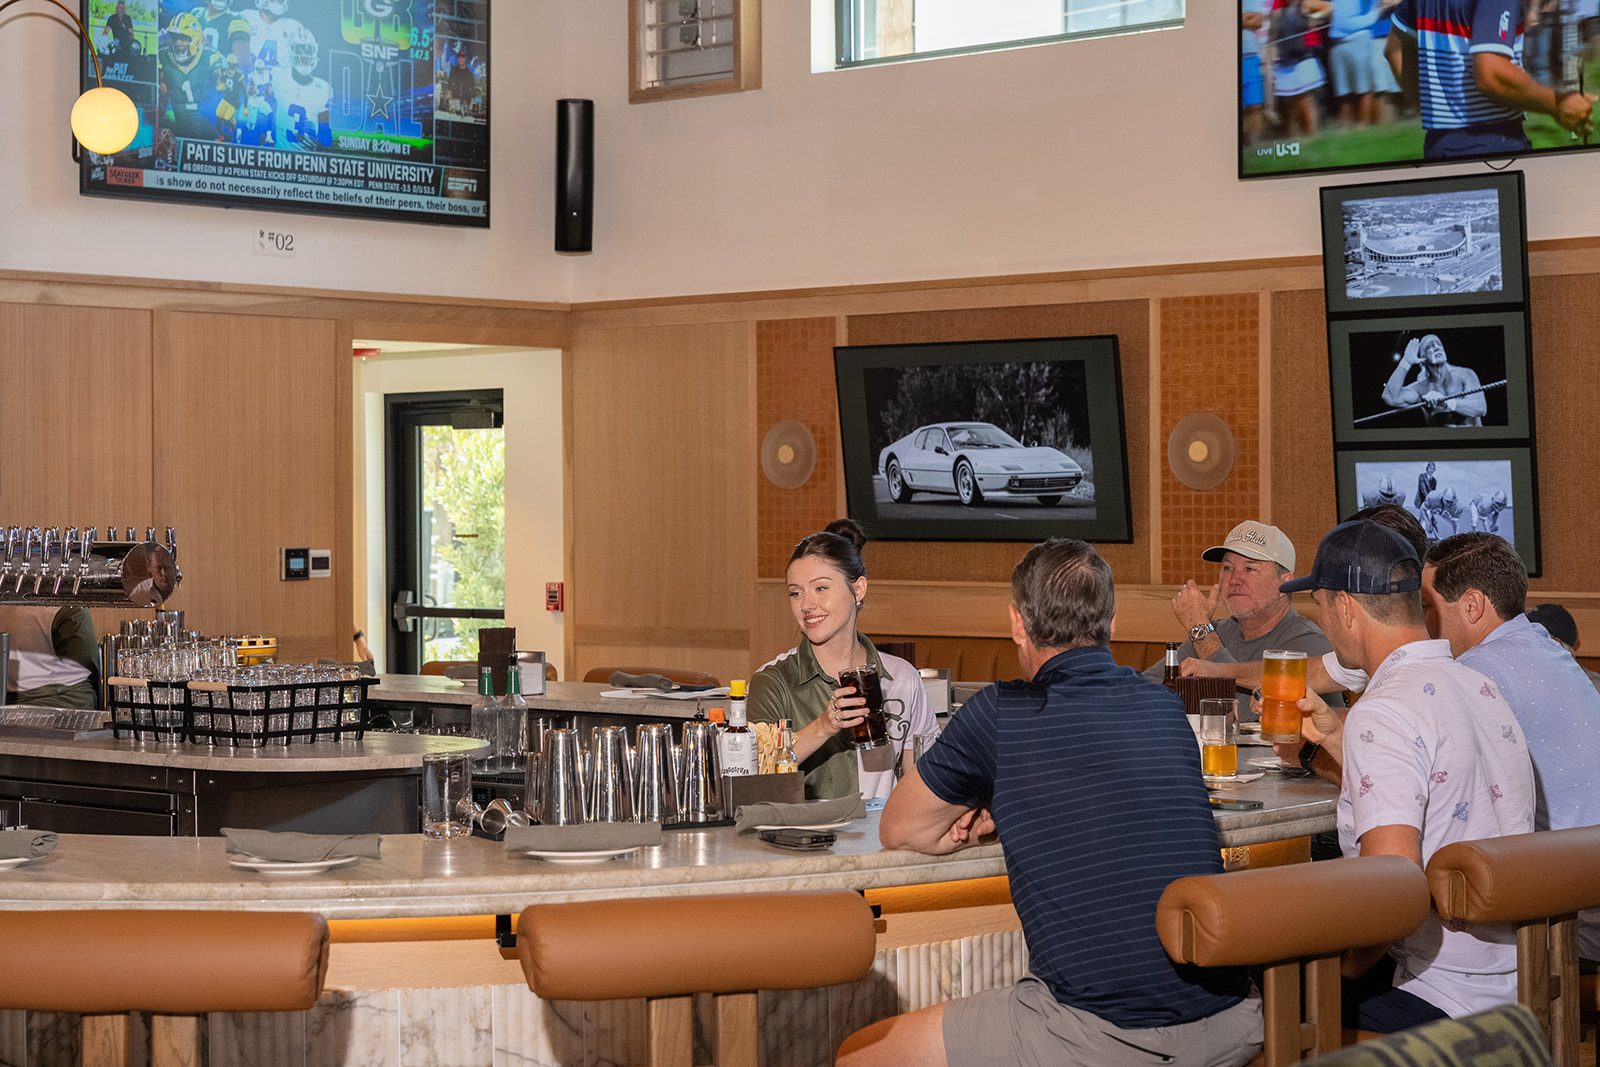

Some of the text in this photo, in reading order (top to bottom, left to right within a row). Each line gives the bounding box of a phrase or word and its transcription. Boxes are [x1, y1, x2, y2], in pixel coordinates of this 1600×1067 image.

[362, 43, 398, 60] SNF
[114, 62, 128, 75] PAT
[182, 81, 198, 110] 1
[339, 136, 411, 155] SUNDAY 8:20PM ET
[187, 143, 210, 161] PAT
[213, 145, 226, 163] IS
[228, 147, 254, 166] LIVE
[258, 151, 292, 170] FROM
[295, 154, 327, 173] PENN
[330, 158, 365, 177] STATE
[368, 162, 434, 184] UNIVERSITY
[110, 170, 140, 179] SEATGEEK
[192, 164, 216, 174] OREGON
[233, 168, 249, 177] PENN
[250, 169, 267, 179] STATE
[268, 171, 285, 180] KICKS
[286, 172, 297, 182] OFF
[298, 174, 326, 185] SATURDAY
[368, 181, 384, 190] PENN
[384, 182, 400, 192] STATE
[448, 177, 478, 192] ESPN
[167, 177, 192, 187] show
[196, 180, 207, 189] do
[210, 182, 226, 191] not
[228, 184, 280, 198] necessarily
[284, 188, 313, 198] reflect
[316, 190, 330, 200] the
[333, 192, 362, 203] beliefs
[365, 194, 374, 204] of
[376, 196, 396, 206] their
[398, 199, 424, 210] peers,
[427, 201, 446, 211] their
[448, 202, 470, 214] boss,
